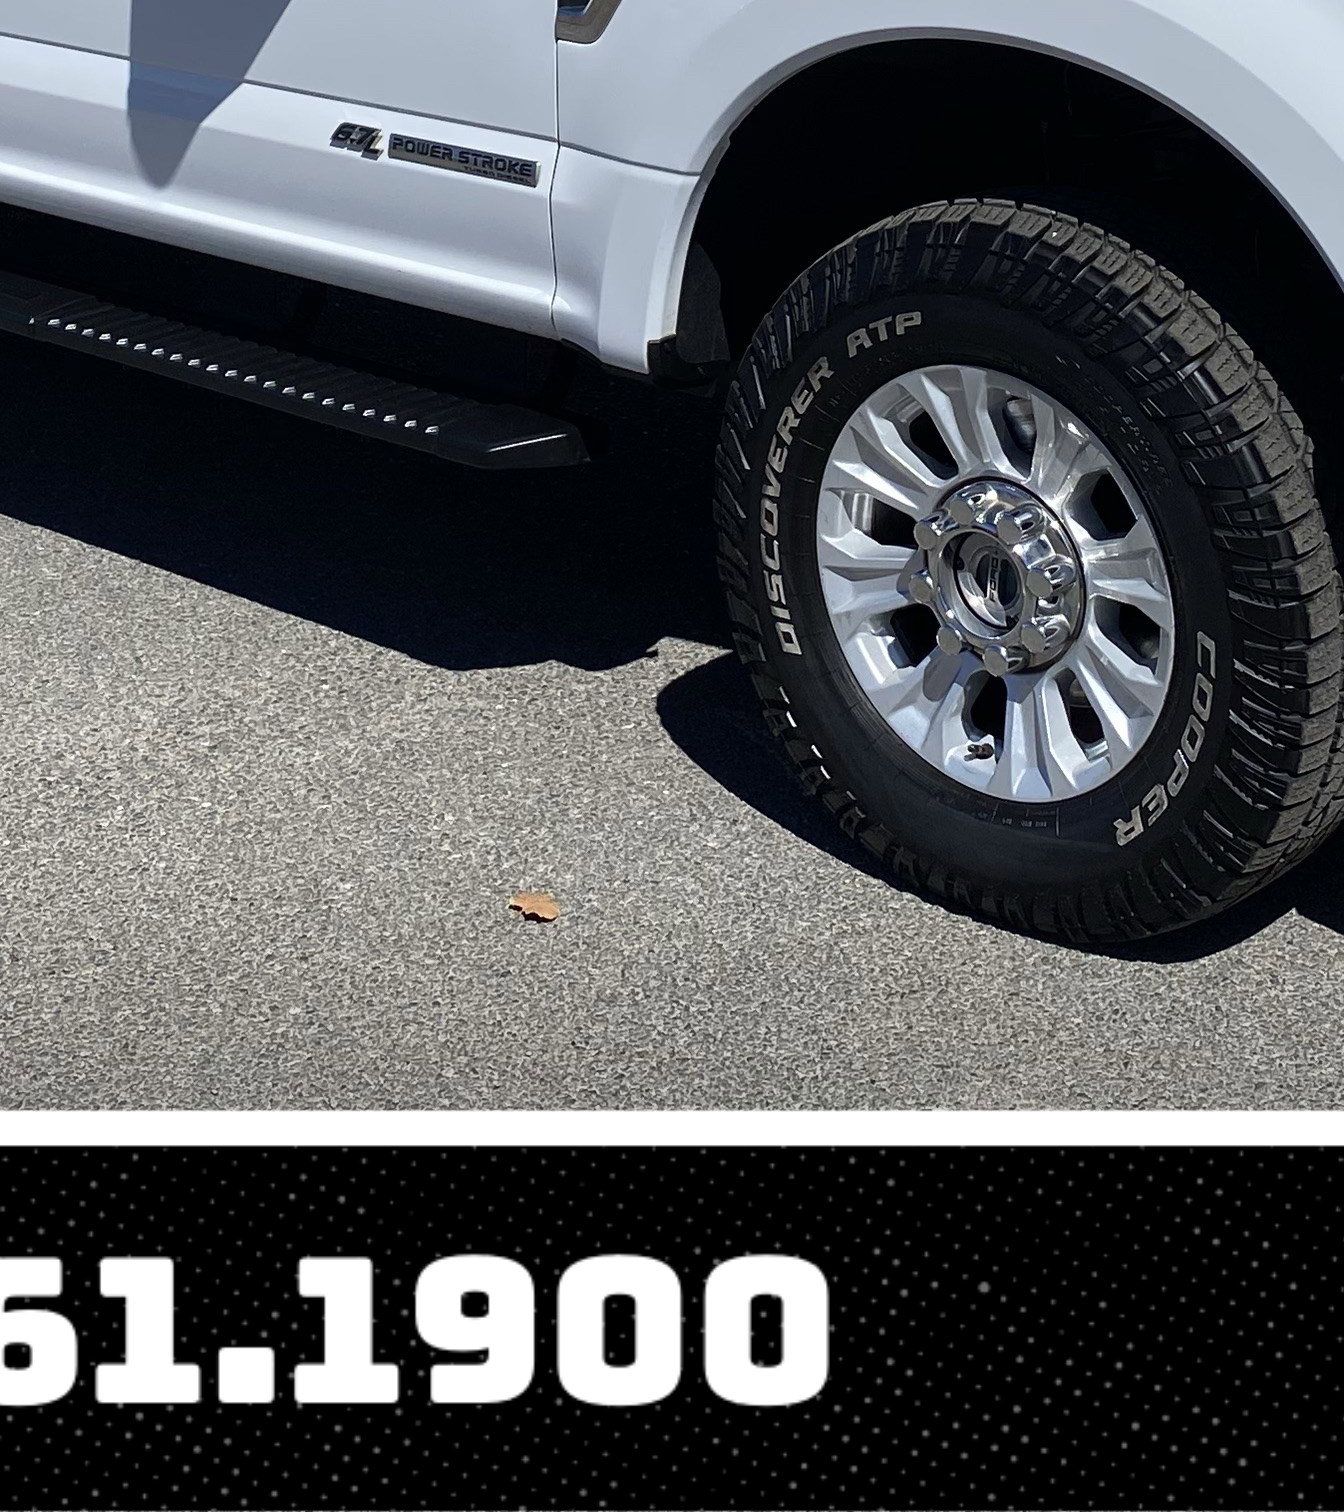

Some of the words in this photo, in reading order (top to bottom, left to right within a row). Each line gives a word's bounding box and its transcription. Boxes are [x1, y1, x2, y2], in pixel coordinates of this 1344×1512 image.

[391, 138, 453, 161] POWER
[458, 150, 533, 178] STROKE
[758, 355, 834, 656] DISCOVERER
[845, 310, 923, 359] ATP
[1111, 630, 1217, 847] COOPER
